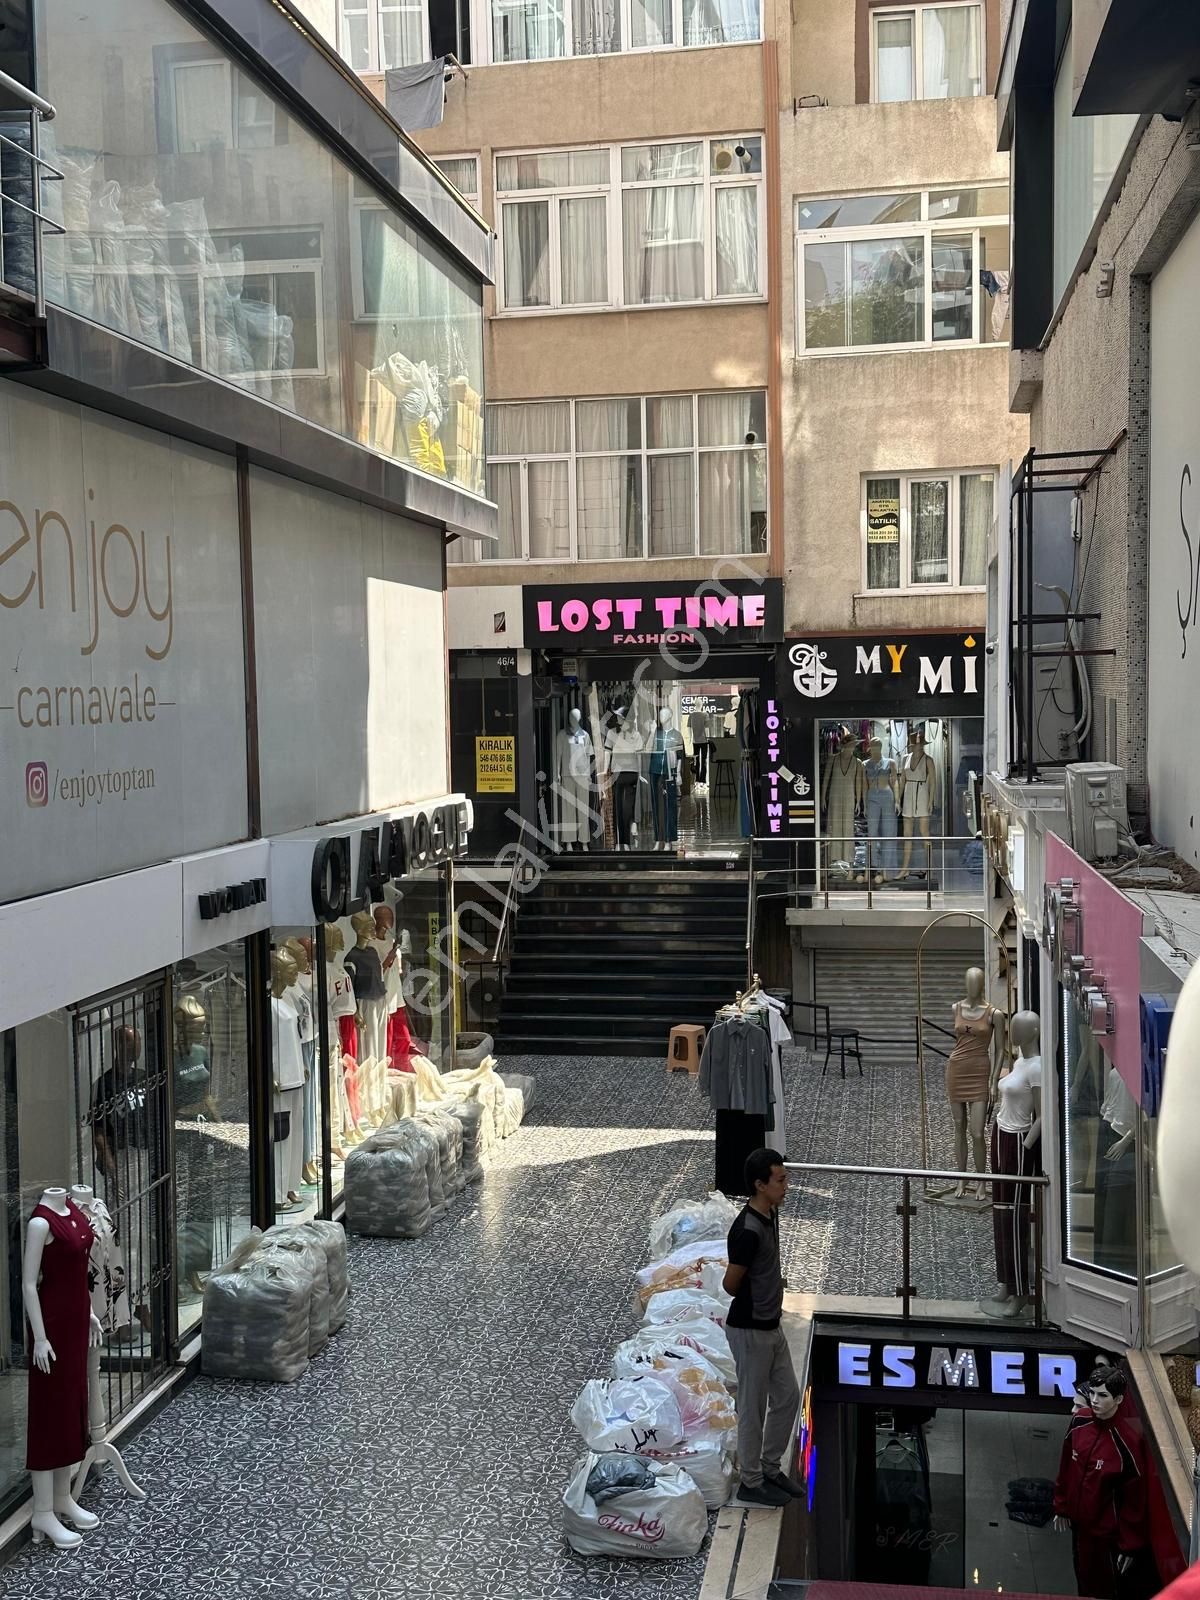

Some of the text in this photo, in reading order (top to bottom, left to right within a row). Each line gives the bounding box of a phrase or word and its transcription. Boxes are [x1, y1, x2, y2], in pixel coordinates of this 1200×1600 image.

[0, 488, 173, 660] enjoy
[537, 595, 765, 632] LOST TIME
[497, 657, 515, 666] 46/4
[613, 633, 694, 644] FASHION
[855, 644, 908, 675] MY
[17, 672, 156, 728] carnavale
[766, 700, 782, 833] LOST TIME
[838, 1342, 1077, 1398] ESMER
